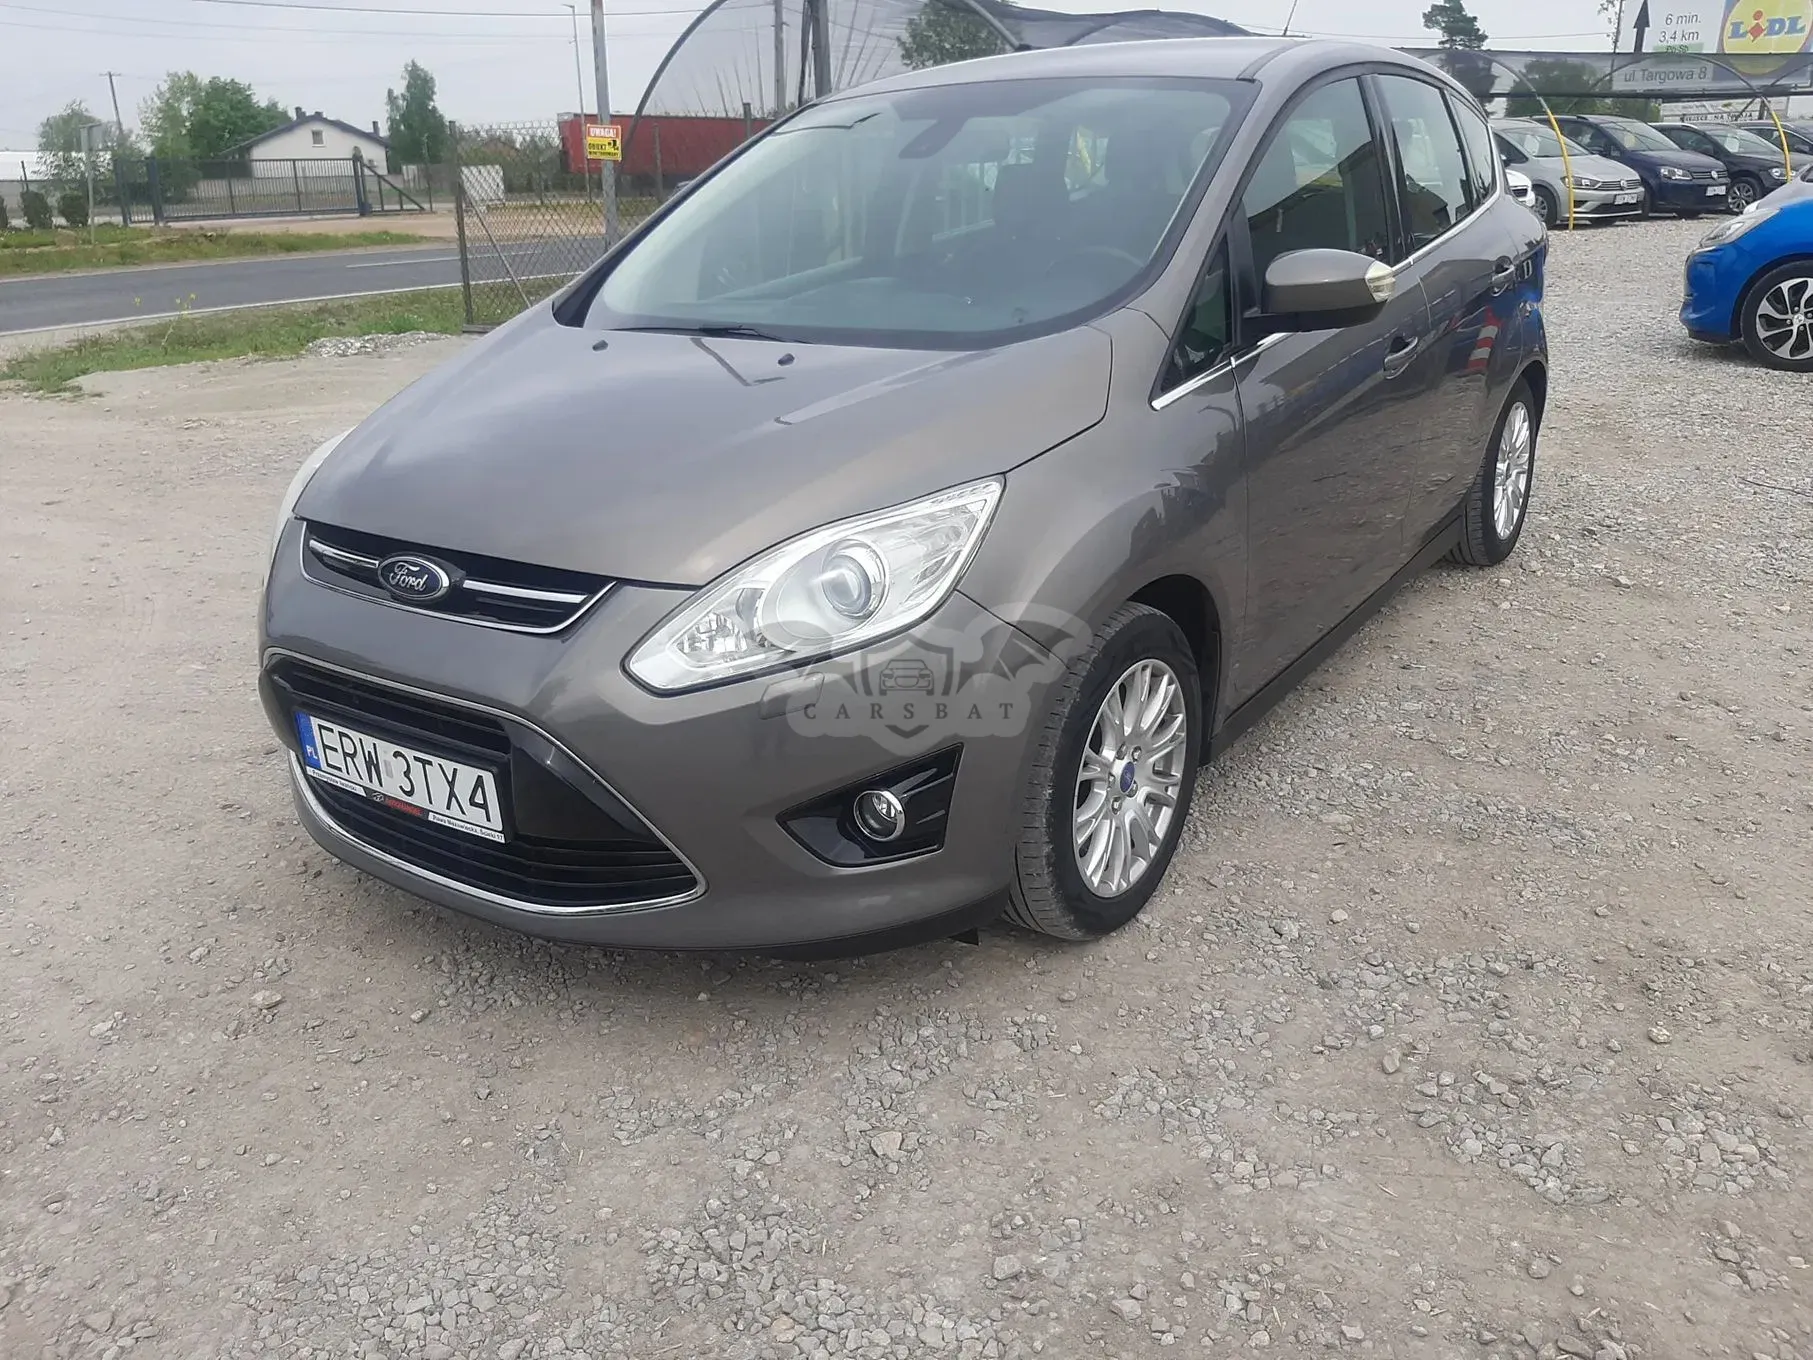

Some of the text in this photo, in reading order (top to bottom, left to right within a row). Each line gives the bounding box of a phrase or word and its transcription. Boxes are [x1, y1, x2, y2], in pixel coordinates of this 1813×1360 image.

[1665, 13, 1702, 26] 6 min.
[1659, 29, 1700, 43] 3,4 km
[1641, 68, 1694, 84] Targowa
[1698, 66, 1707, 80] 8
[389, 561, 428, 592] Ford
[306, 744, 318, 760] PL
[317, 723, 492, 823] ERW 3TX4
